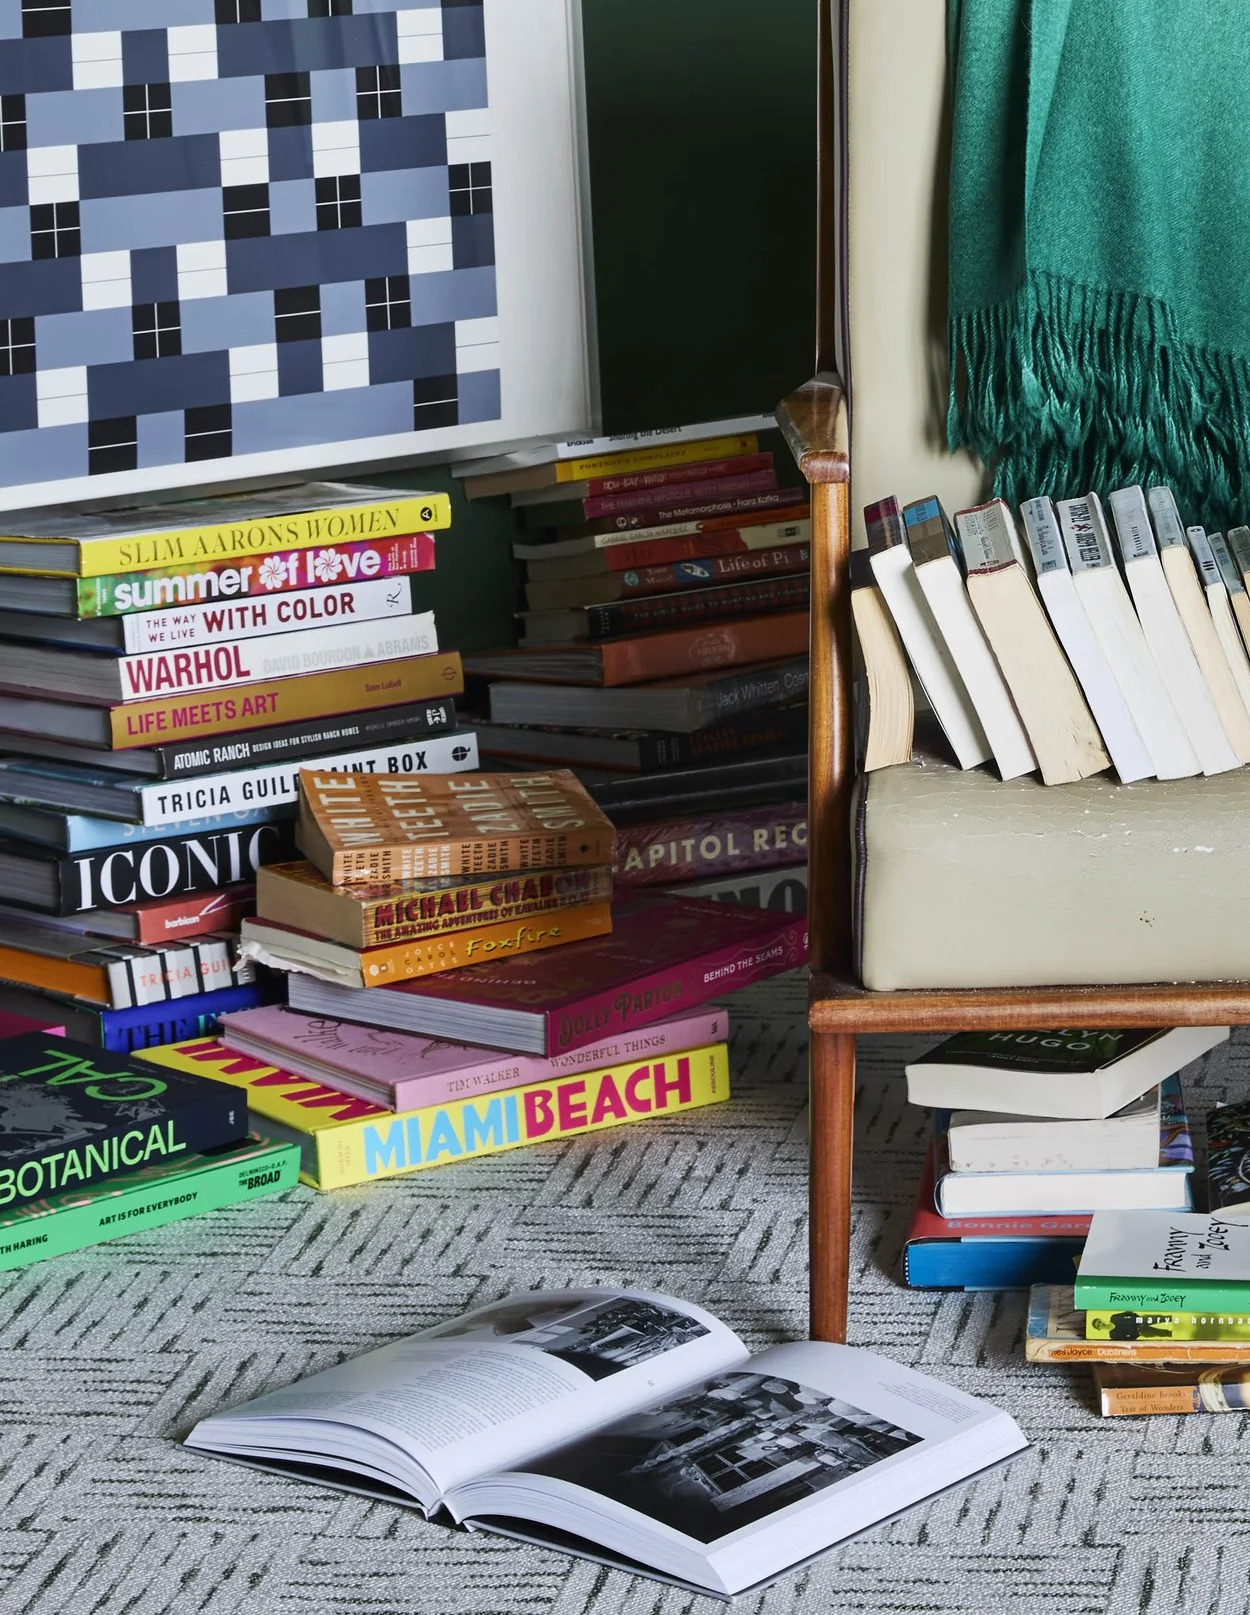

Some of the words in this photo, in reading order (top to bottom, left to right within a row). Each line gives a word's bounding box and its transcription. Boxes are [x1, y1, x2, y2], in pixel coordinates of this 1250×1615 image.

[658, 511, 672, 520] The
[673, 501, 732, 518] Metamorphosis
[736, 497, 757, 508] Franz
[758, 494, 779, 505] Kafka
[119, 536, 185, 566] SLIM
[193, 521, 299, 557] AARONS
[306, 508, 400, 539] WOMEN
[718, 557, 750, 574] Life
[752, 553, 769, 569] of
[773, 551, 789, 566] Pi
[114, 566, 252, 610] summer
[306, 547, 381, 583] love
[146, 616, 168, 630] THE
[173, 614, 196, 626] WAY
[203, 604, 266, 634] WITH
[277, 592, 355, 623] COLOR
[148, 630, 165, 643] WE
[171, 628, 196, 641] LIVE
[126, 645, 250, 695] WARHOL
[263, 658, 300, 675] DAVID
[304, 646, 361, 668] BOURDON
[378, 635, 430, 657] ABRAMS
[717, 692, 740, 709] Jack
[741, 679, 780, 701] Whitten
[127, 711, 167, 736] LIFE
[172, 700, 237, 729] MEETS
[241, 693, 279, 717] ART
[174, 749, 211, 771] ATOMIC
[213, 743, 250, 764] RANCH
[252, 743, 273, 753] DESIGN
[289, 737, 300, 746] FOR
[301, 732, 323, 745] STYLISH
[157, 785, 231, 815] TRICIA
[388, 751, 428, 774] BOX
[312, 776, 384, 846] WHITE
[378, 781, 449, 840] TEETH
[448, 780, 520, 835] ZADIE
[510, 776, 585, 830] SMITH
[382, 850, 391, 880] SMITH
[402, 848, 412, 878] WHITE
[415, 847, 425, 877] TEETH
[428, 846, 438, 876] ZADIE
[441, 845, 450, 876] SMITH
[461, 843, 471, 873] WHITE
[474, 842, 483, 872] TEETH
[488, 842, 497, 872] ZADIE
[500, 840, 509, 872] SMITH
[520, 838, 529, 868] WHITE
[532, 837, 541, 867] TEETH
[611, 832, 740, 873] APITOL
[74, 826, 280, 911] ICONIC
[374, 888, 483, 928] MICHAEL
[490, 868, 591, 904] CHABON
[164, 914, 200, 929] barbican
[393, 922, 440, 940] AMAZING
[442, 910, 498, 929] ADVENTURES
[405, 941, 455, 959] JOYCE
[405, 949, 456, 965] CAROL
[465, 926, 561, 958] Foxfire
[139, 968, 192, 988] TRICIA
[406, 957, 458, 975] OATES
[704, 964, 736, 983] BEHIND
[737, 957, 754, 971] THE
[755, 946, 784, 964] SEAMS
[558, 1003, 611, 1047] DOLLY
[613, 979, 683, 1023] PARTON
[988, 1033, 1091, 1051] HUGO
[447, 1080, 472, 1093] TIM
[473, 1067, 520, 1088] WALKER
[549, 1045, 621, 1069] WONDERFUL
[623, 1035, 666, 1054] THINGS
[362, 1095, 521, 1175] MIAMI
[524, 1057, 692, 1139] BEACH
[0, 1120, 187, 1206] BOTANICAL
[247, 1169, 282, 1190] BROAD
[99, 1216, 116, 1227] ART
[118, 1213, 127, 1223] IS
[128, 1207, 146, 1221] FOR
[146, 1192, 199, 1214] EVERYBODY
[947, 1221, 1033, 1230] Bonnie
[13, 1234, 48, 1253] HARING
[1135, 1316, 1180, 1327] marya
[1067, 1348, 1093, 1358] Joyce
[1097, 1348, 1137, 1357] Dubliners
[1116, 1391, 1157, 1400] Geraldine
[1159, 1390, 1186, 1399] Brooks
[1150, 1403, 1184, 1413] Wonders
